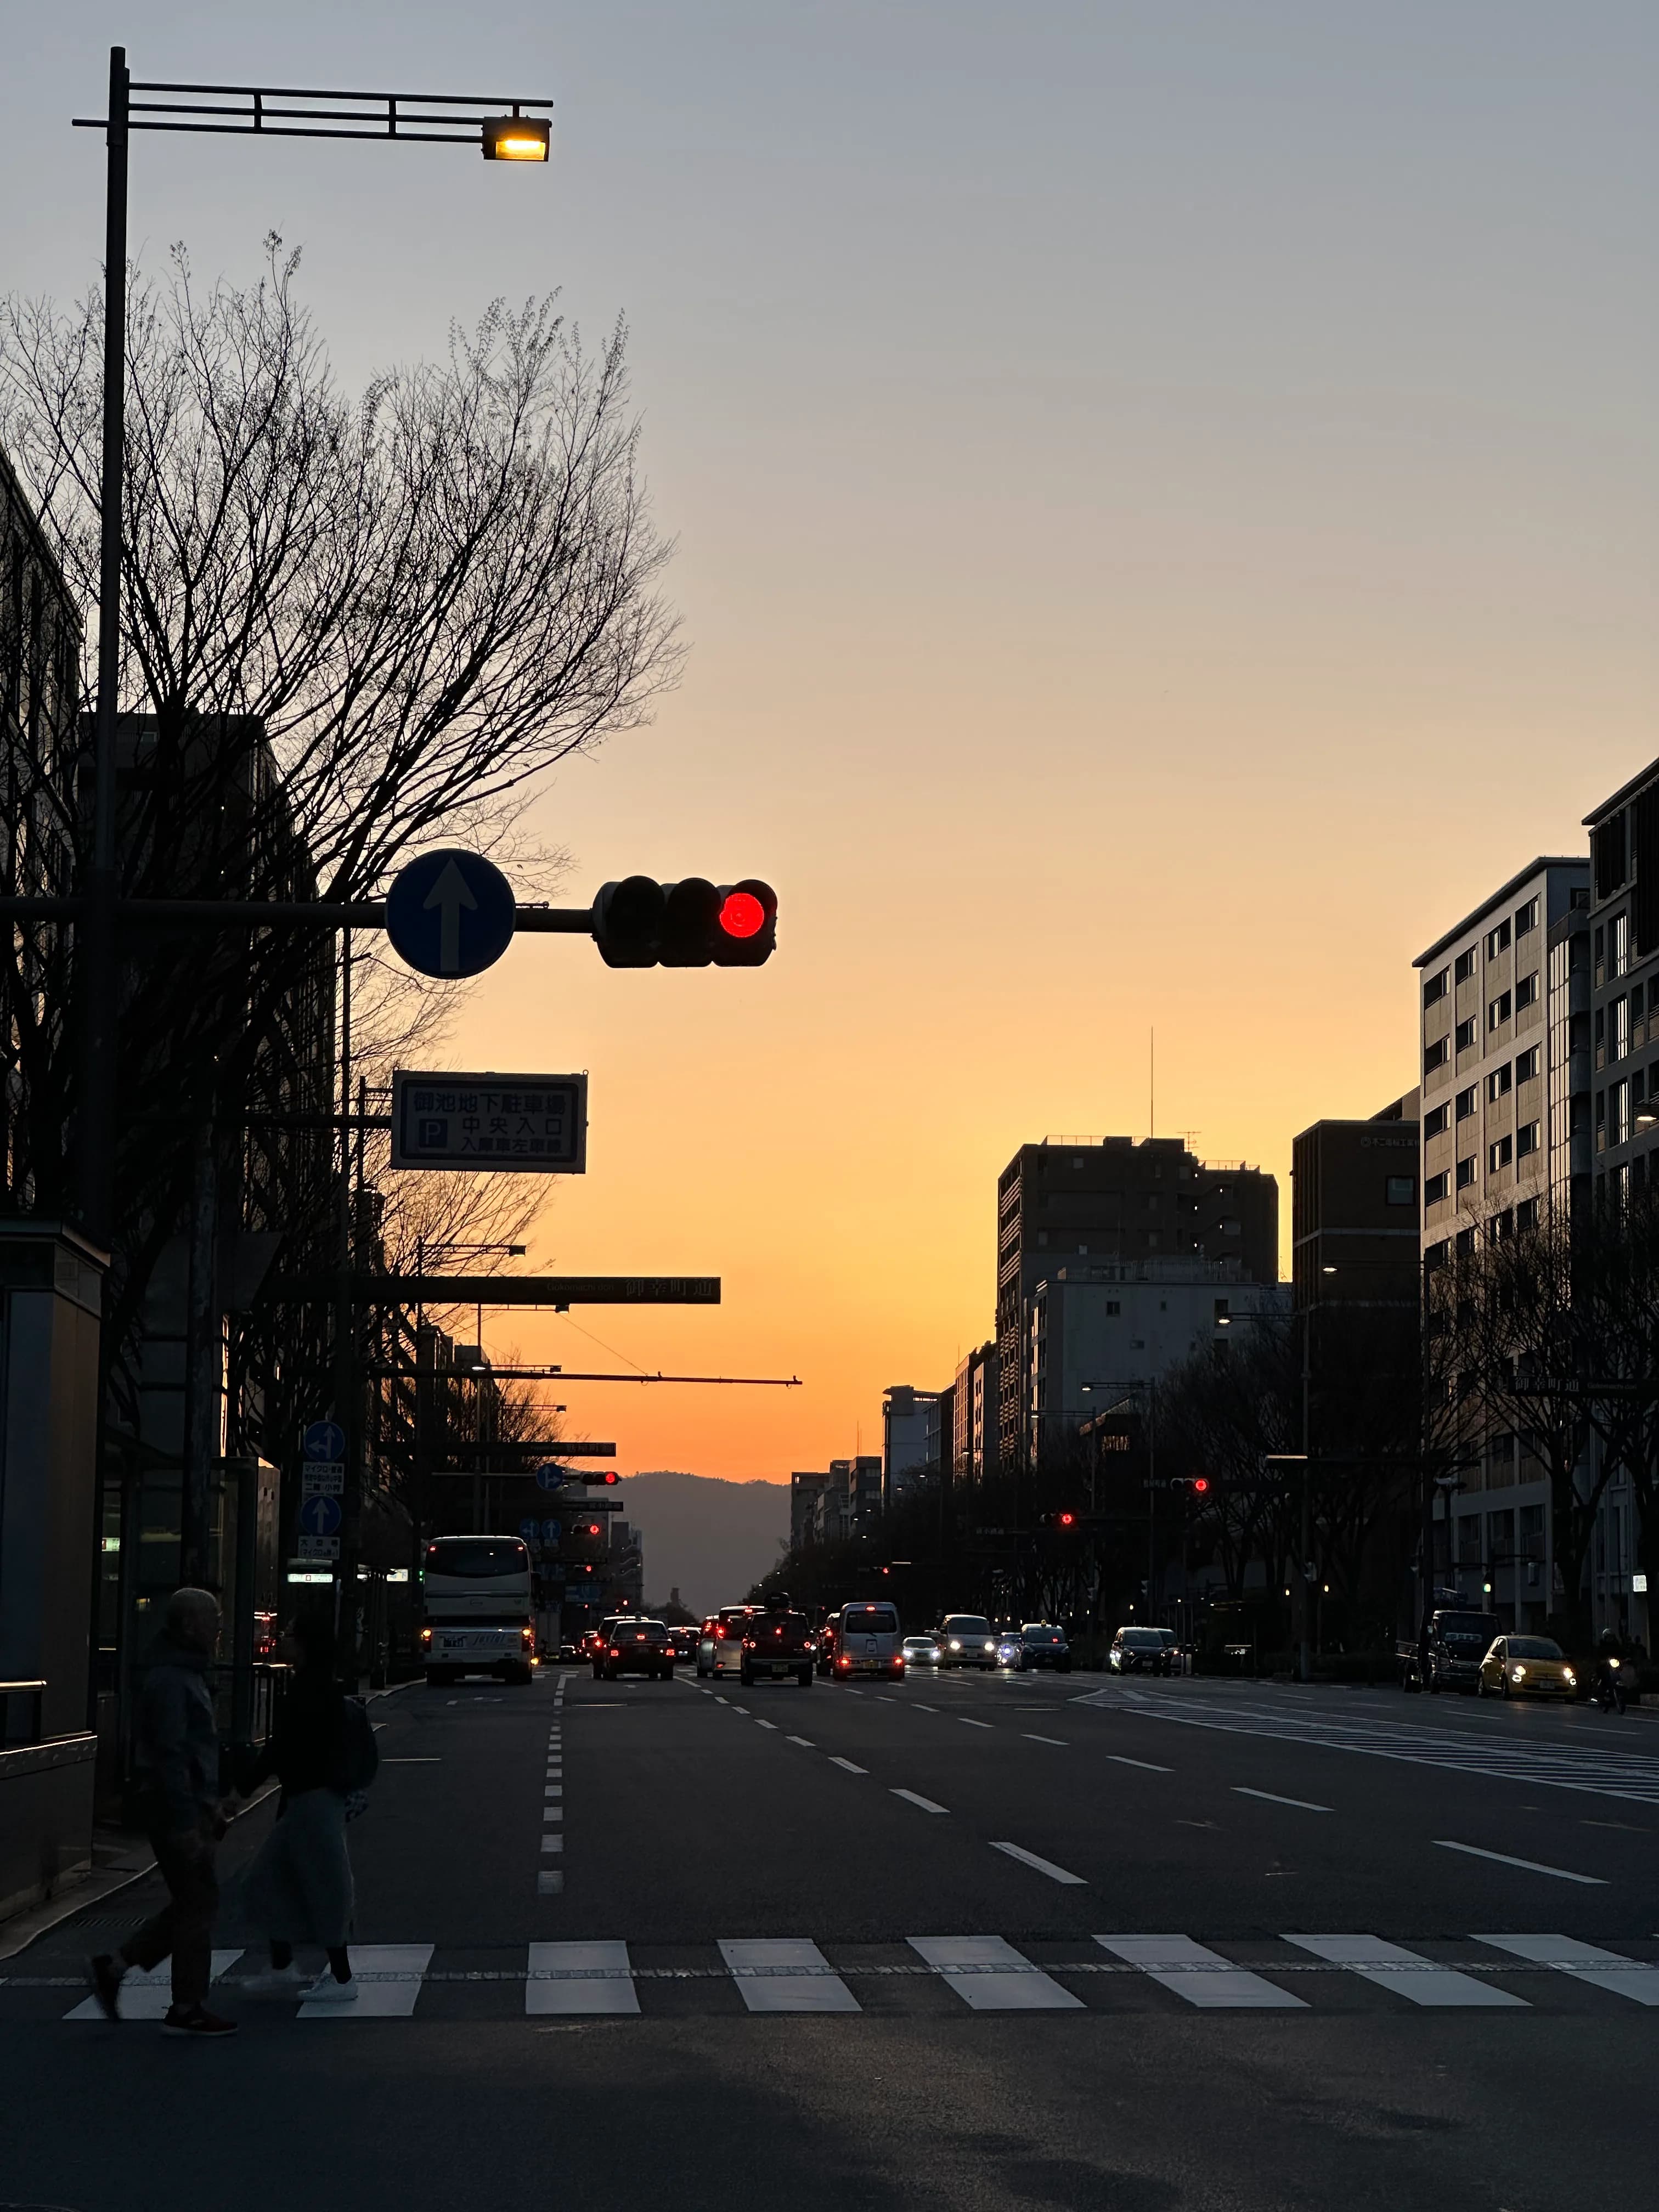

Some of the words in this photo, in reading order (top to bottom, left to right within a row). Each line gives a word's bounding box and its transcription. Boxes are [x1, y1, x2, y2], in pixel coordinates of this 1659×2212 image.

[414, 1091, 566, 1115] 御池地下駐車場
[425, 1122, 441, 1145] P
[625, 1278, 712, 1297] 御幸町通
[1515, 1376, 1580, 1392] 御幸町通
